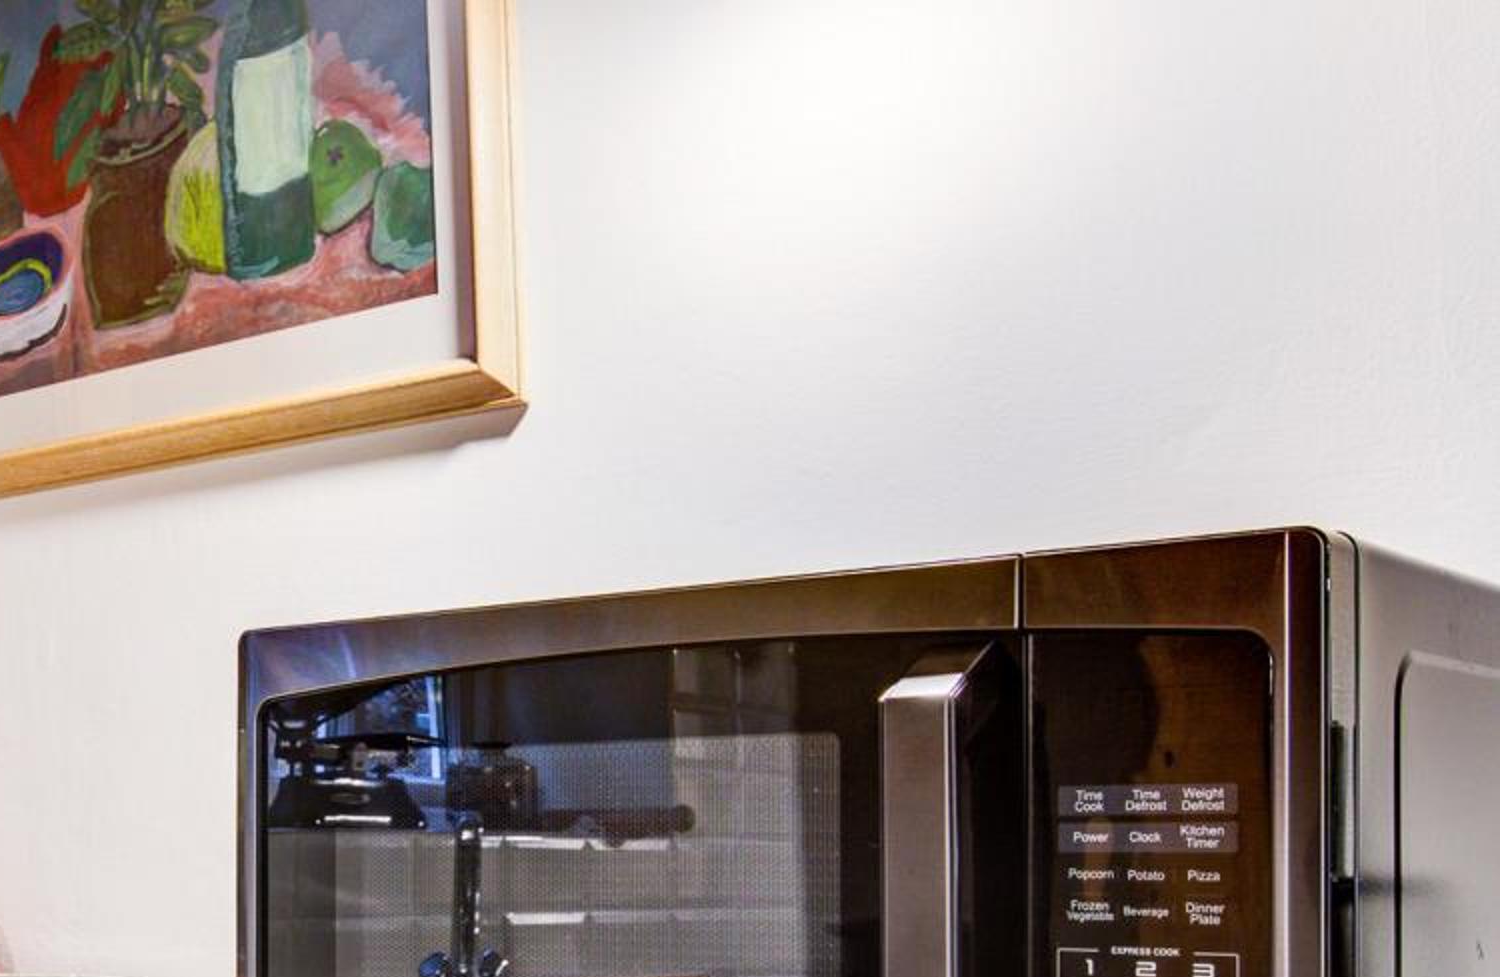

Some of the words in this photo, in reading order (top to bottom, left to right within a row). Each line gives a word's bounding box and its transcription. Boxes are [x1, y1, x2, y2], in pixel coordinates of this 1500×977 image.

[1076, 790, 1102, 800] Time
[1132, 790, 1160, 800] Time
[1182, 788, 1224, 799] Weight
[1074, 801, 1104, 812] Cook
[1125, 800, 1166, 811] Defrost
[1182, 800, 1224, 811] Defrost
[1180, 826, 1224, 837] Kitchen
[1073, 832, 1109, 843] Power
[1129, 832, 1161, 843] Clock
[1187, 837, 1219, 848] Timer
[1068, 868, 1114, 880] Popcorn
[1127, 870, 1165, 881] Potato
[1188, 870, 1220, 882] Pizza
[1071, 900, 1110, 911] Frozen
[1185, 902, 1225, 914] Dinner
[1123, 906, 1169, 918] Beverage
[1189, 914, 1221, 925] Plate
[1153, 948, 1181, 957] COOK
[1085, 958, 1095, 976] 1
[1135, 961, 1157, 977] 2
